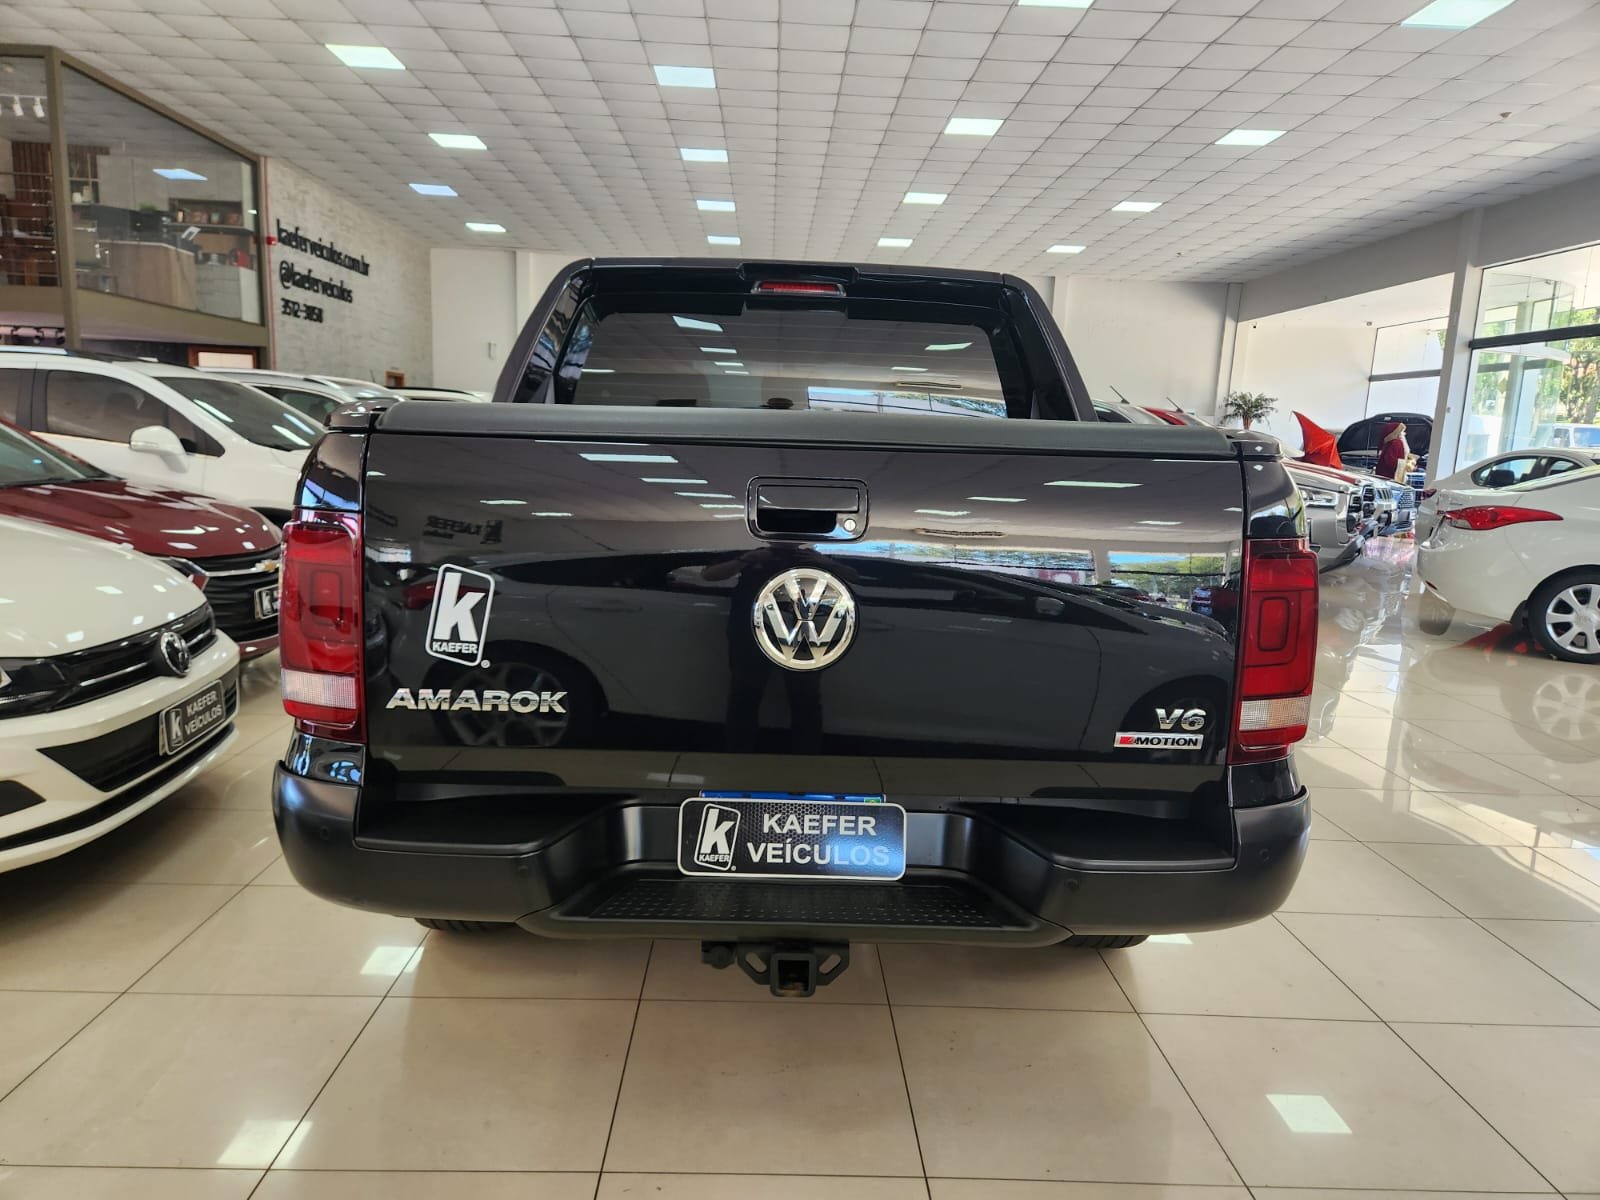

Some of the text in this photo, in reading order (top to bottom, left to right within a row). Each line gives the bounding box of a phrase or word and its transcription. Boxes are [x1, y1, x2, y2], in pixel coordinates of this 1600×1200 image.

[432, 641, 478, 654] KAEFER
[186, 690, 218, 716] KAEFER
[385, 687, 568, 714] AMAROK
[184, 704, 223, 735] VEÍCULOS
[1155, 708, 1207, 731] V6
[763, 813, 877, 836] KAEFER
[699, 852, 730, 863] KAEFER
[747, 838, 890, 866] VEÍCULOS
